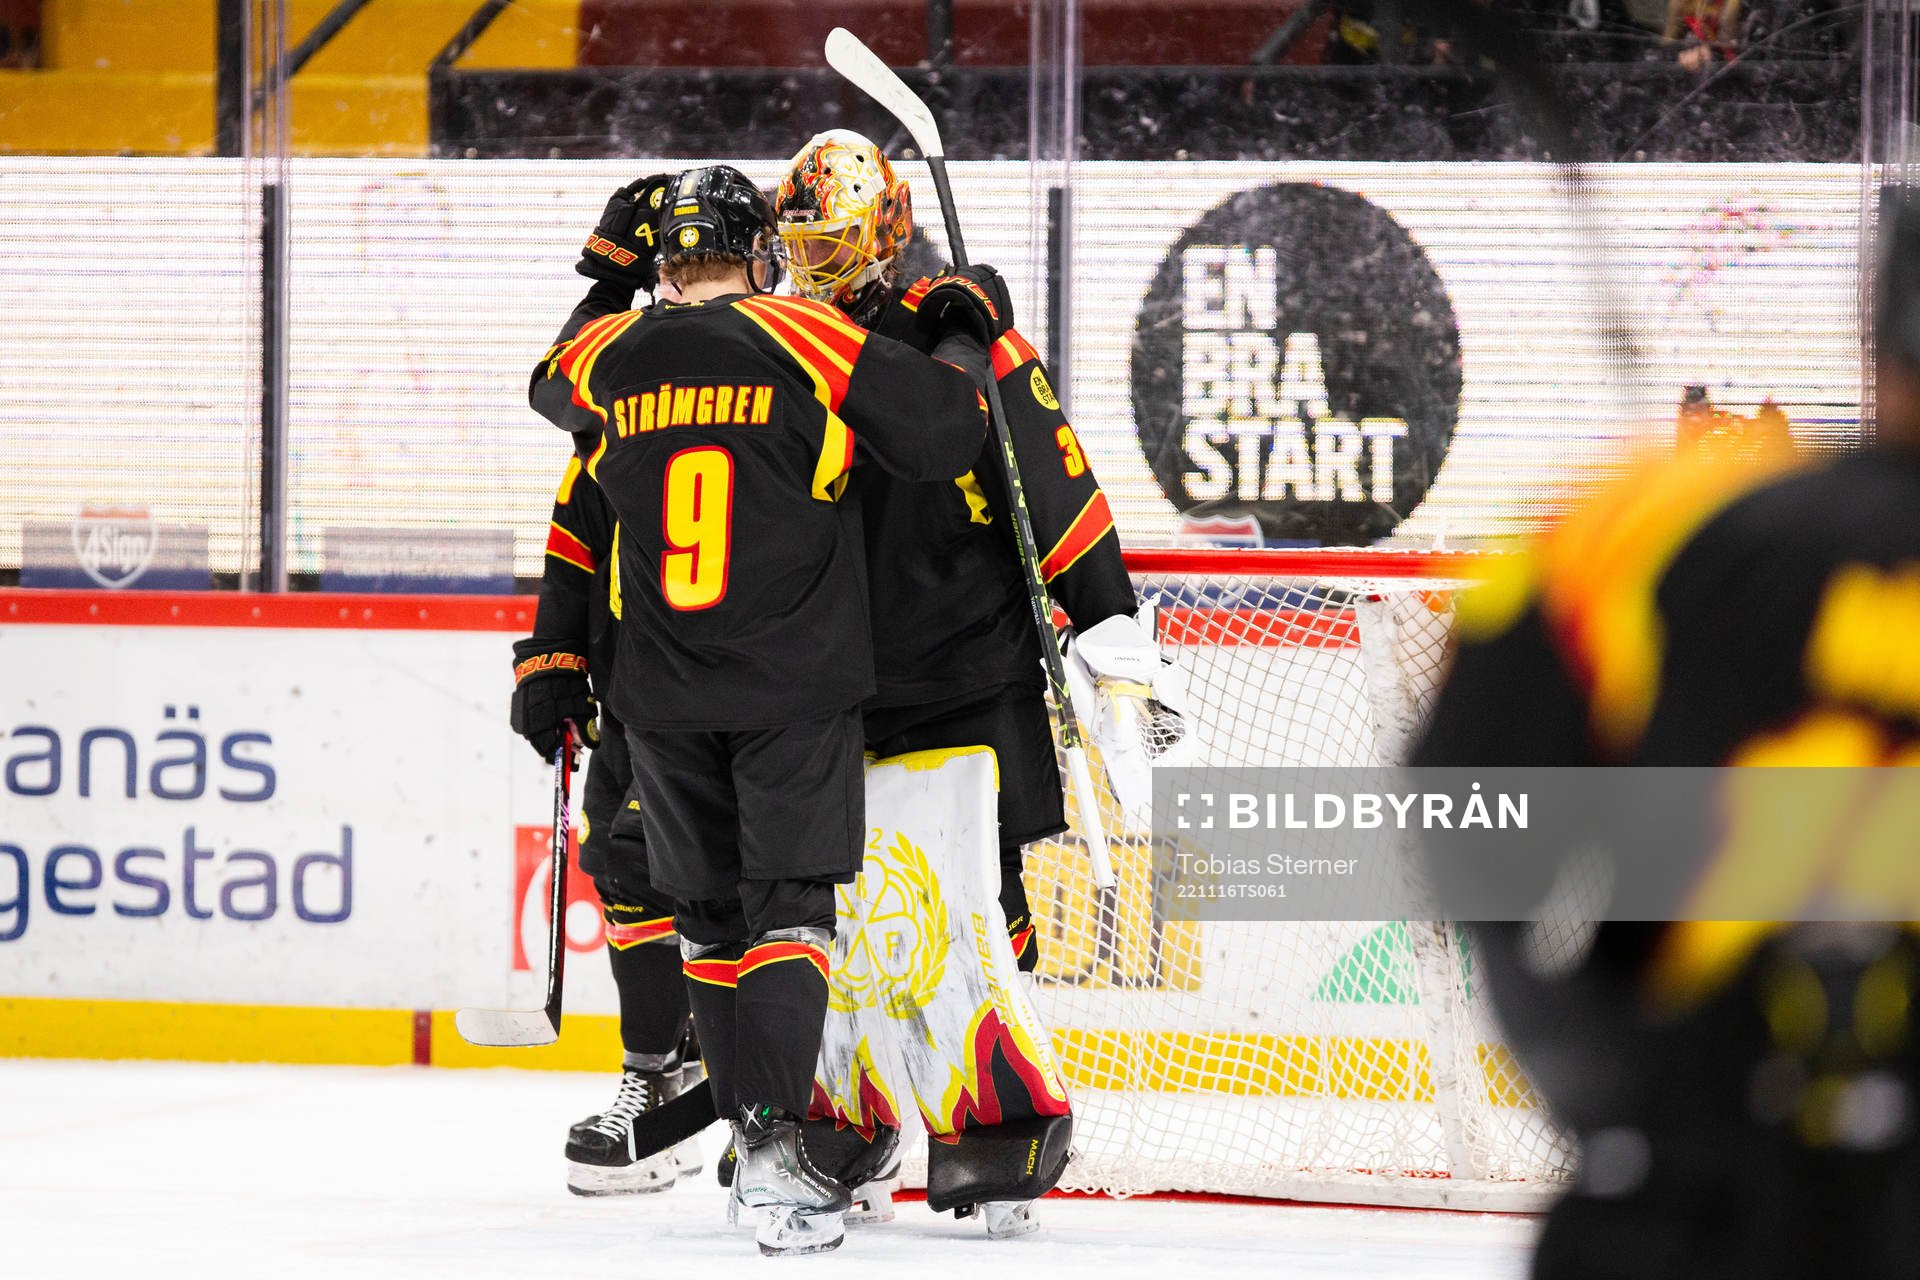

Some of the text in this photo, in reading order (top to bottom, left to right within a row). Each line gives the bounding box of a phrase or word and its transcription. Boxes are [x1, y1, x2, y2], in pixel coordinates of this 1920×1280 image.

[1182, 244, 1277, 329] EN
[613, 383, 773, 439] STRÖMGREN
[1182, 332, 1331, 418] BRA
[1181, 418, 1409, 503] START
[660, 445, 734, 612] 9
[1025, 1139, 1039, 1176] MACH
